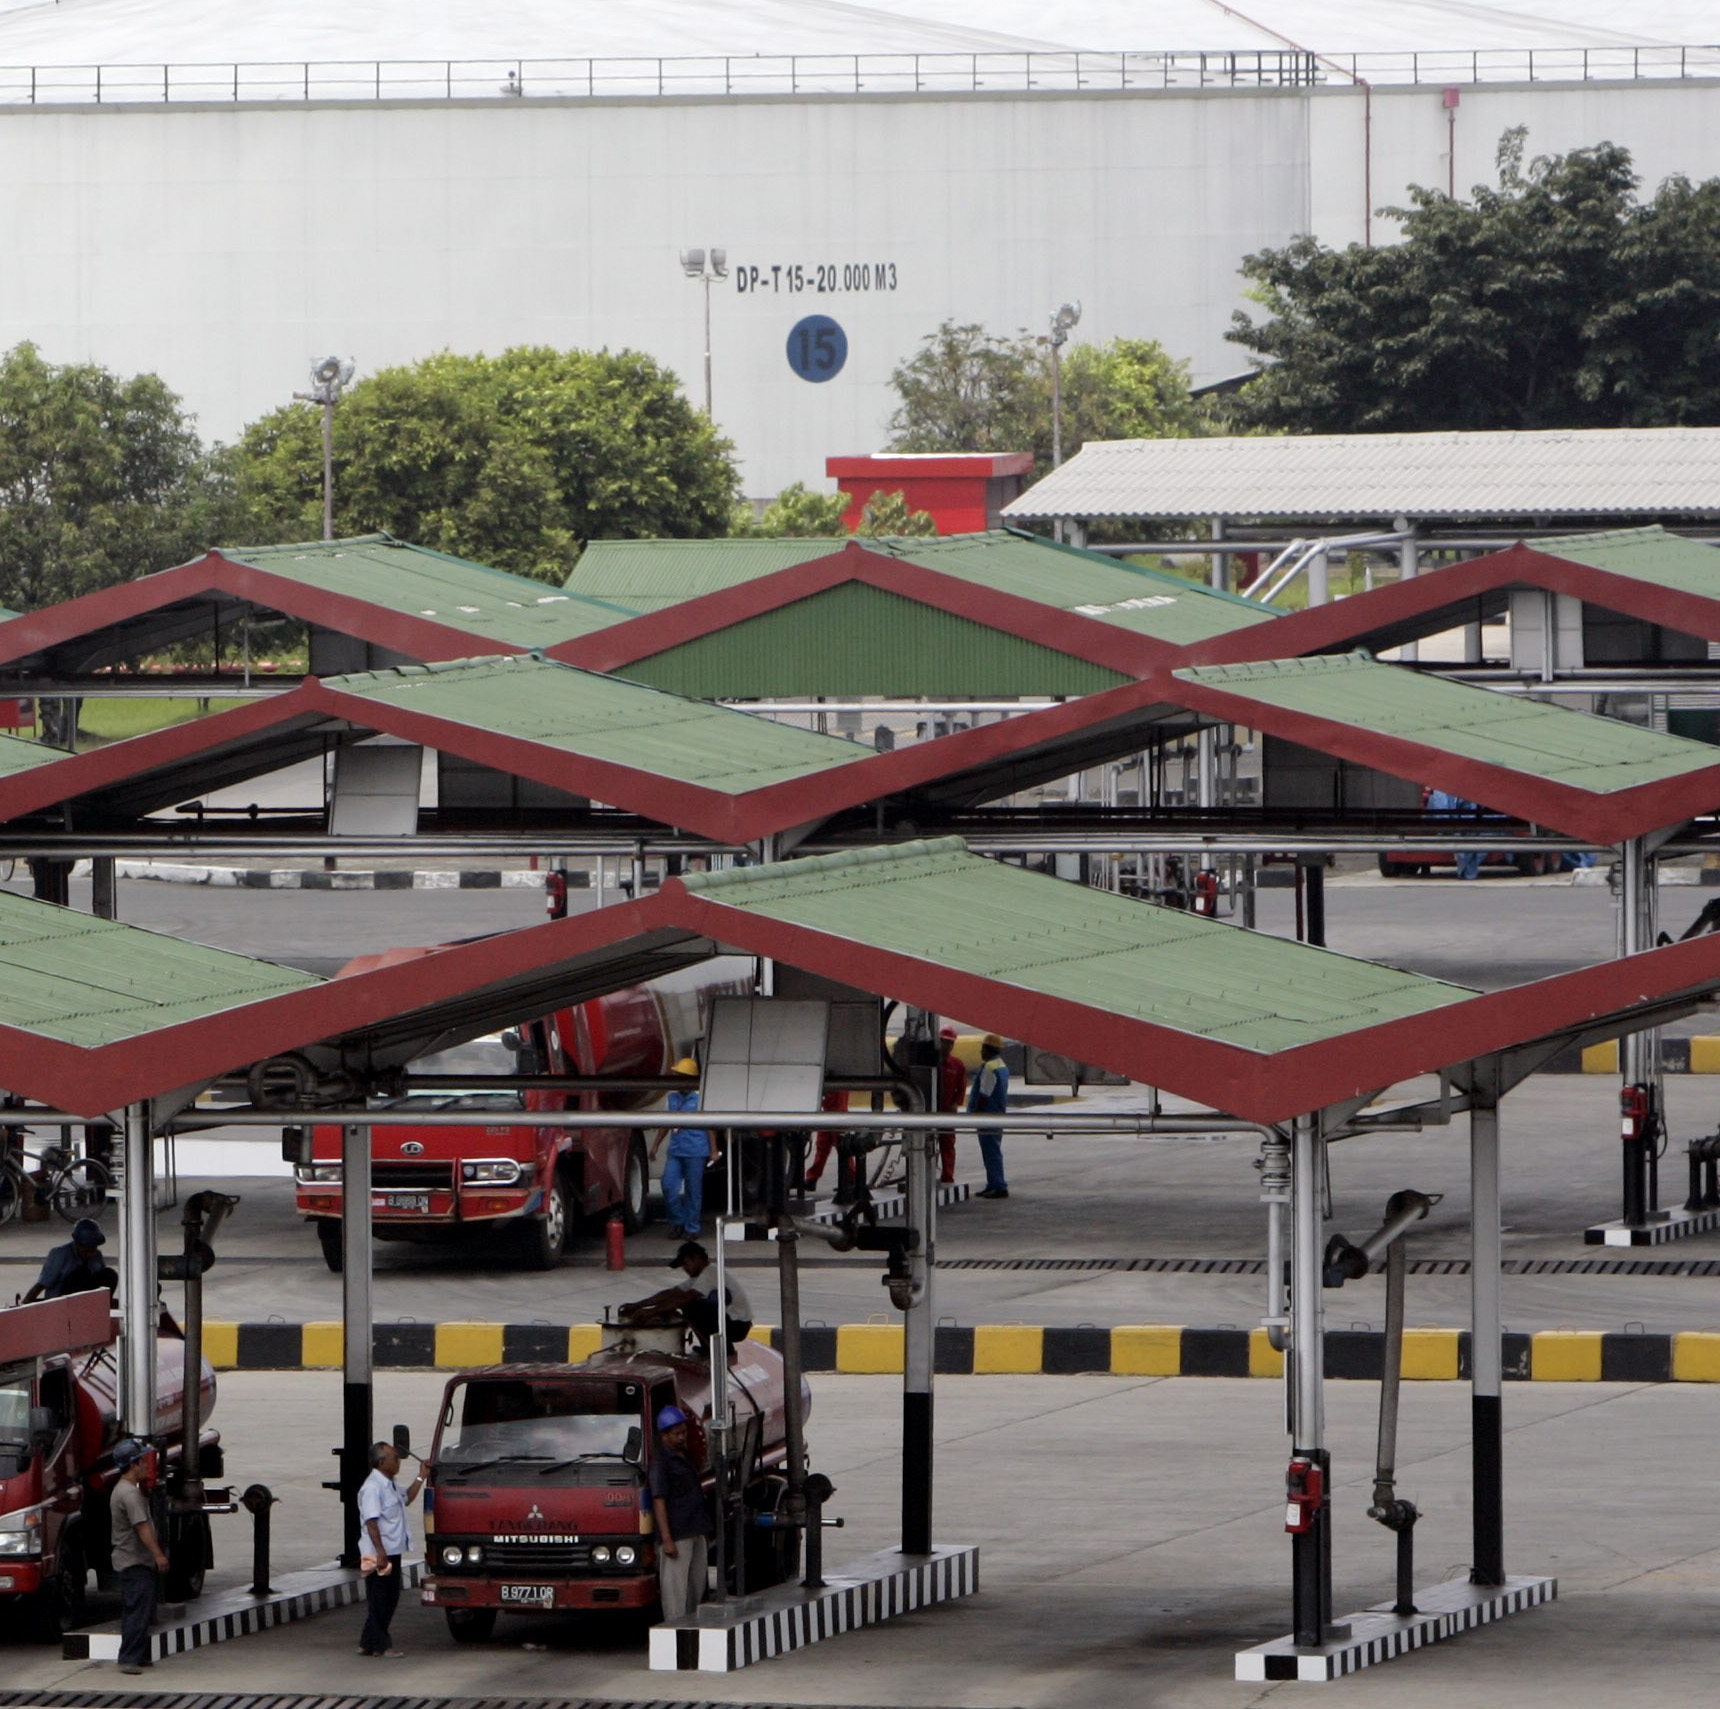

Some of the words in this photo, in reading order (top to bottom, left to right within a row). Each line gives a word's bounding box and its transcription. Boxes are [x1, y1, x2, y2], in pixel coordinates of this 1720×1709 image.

[798, 326, 837, 372] 15
[493, 1535, 579, 1543] MITSUBISHI
[501, 1585, 509, 1599] B
[511, 1585, 537, 1599] 9771
